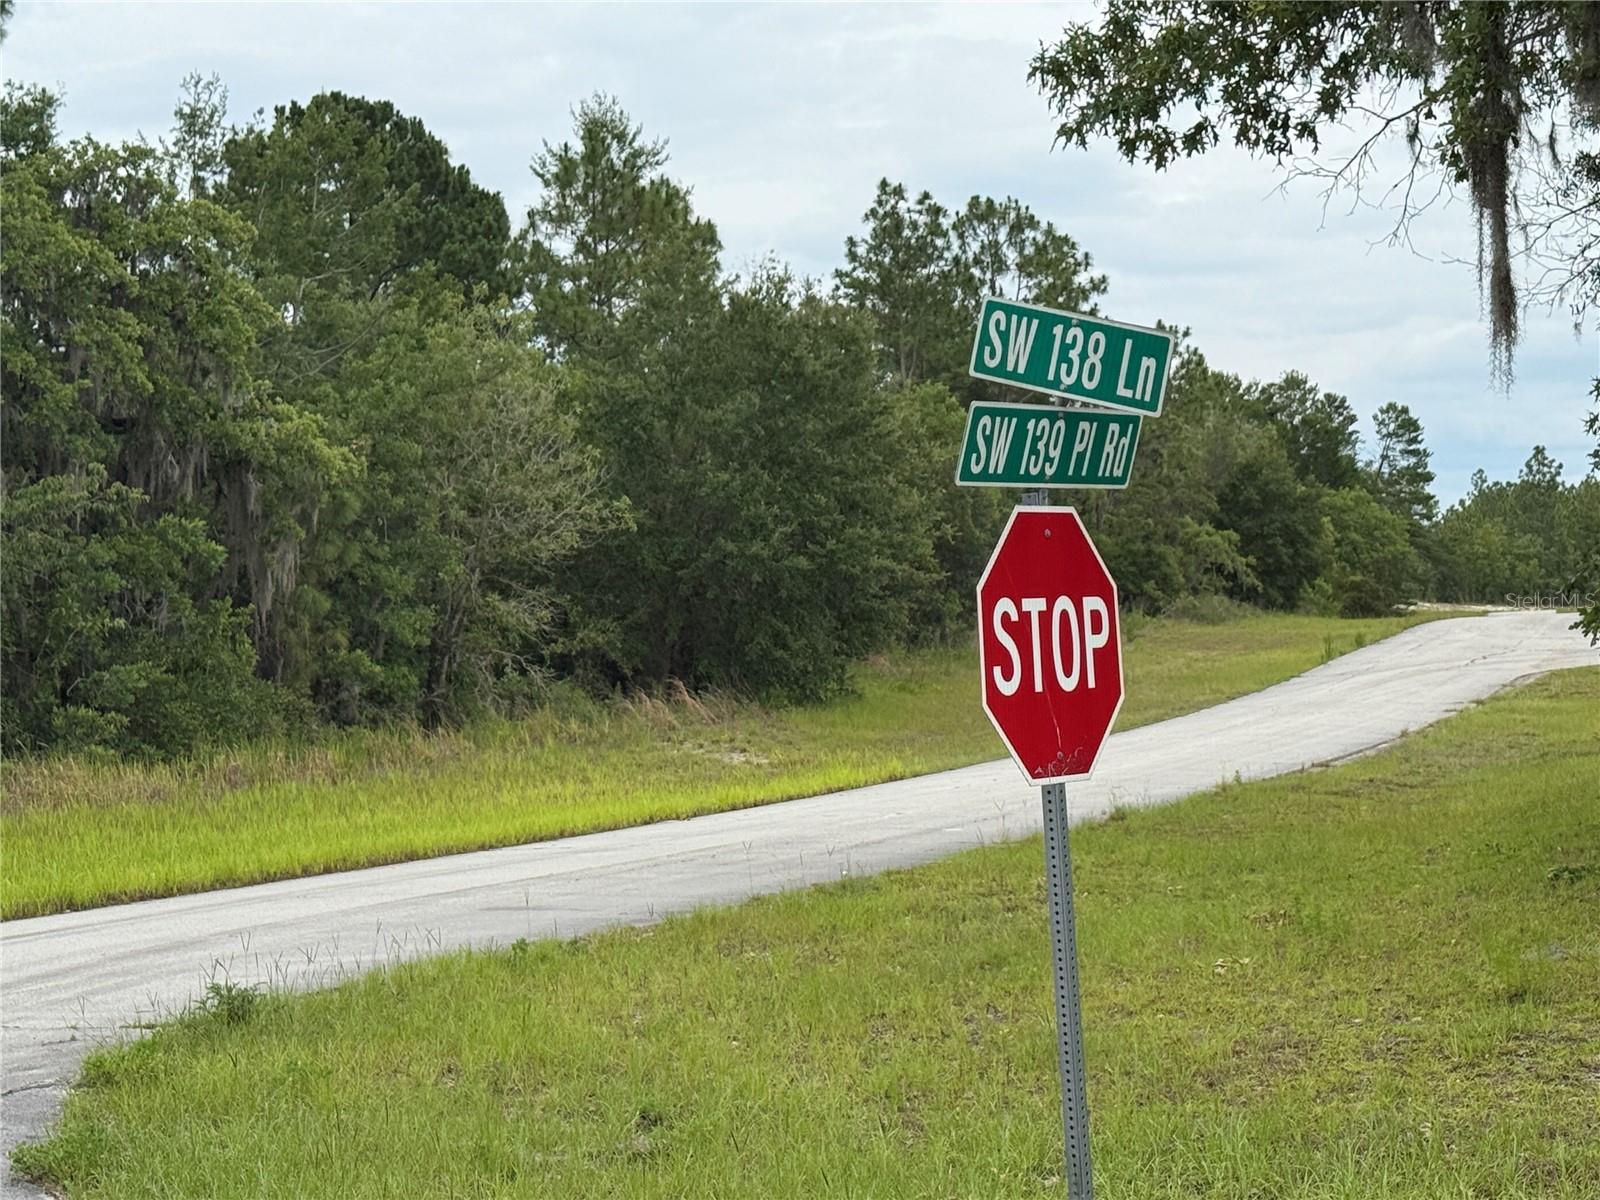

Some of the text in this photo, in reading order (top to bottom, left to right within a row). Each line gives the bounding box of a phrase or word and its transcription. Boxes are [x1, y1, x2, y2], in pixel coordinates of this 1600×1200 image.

[984, 310, 1157, 402] SW 138 Ln
[970, 415, 1133, 478] SW 139 Pl Rd
[993, 595, 1110, 697] STOP
